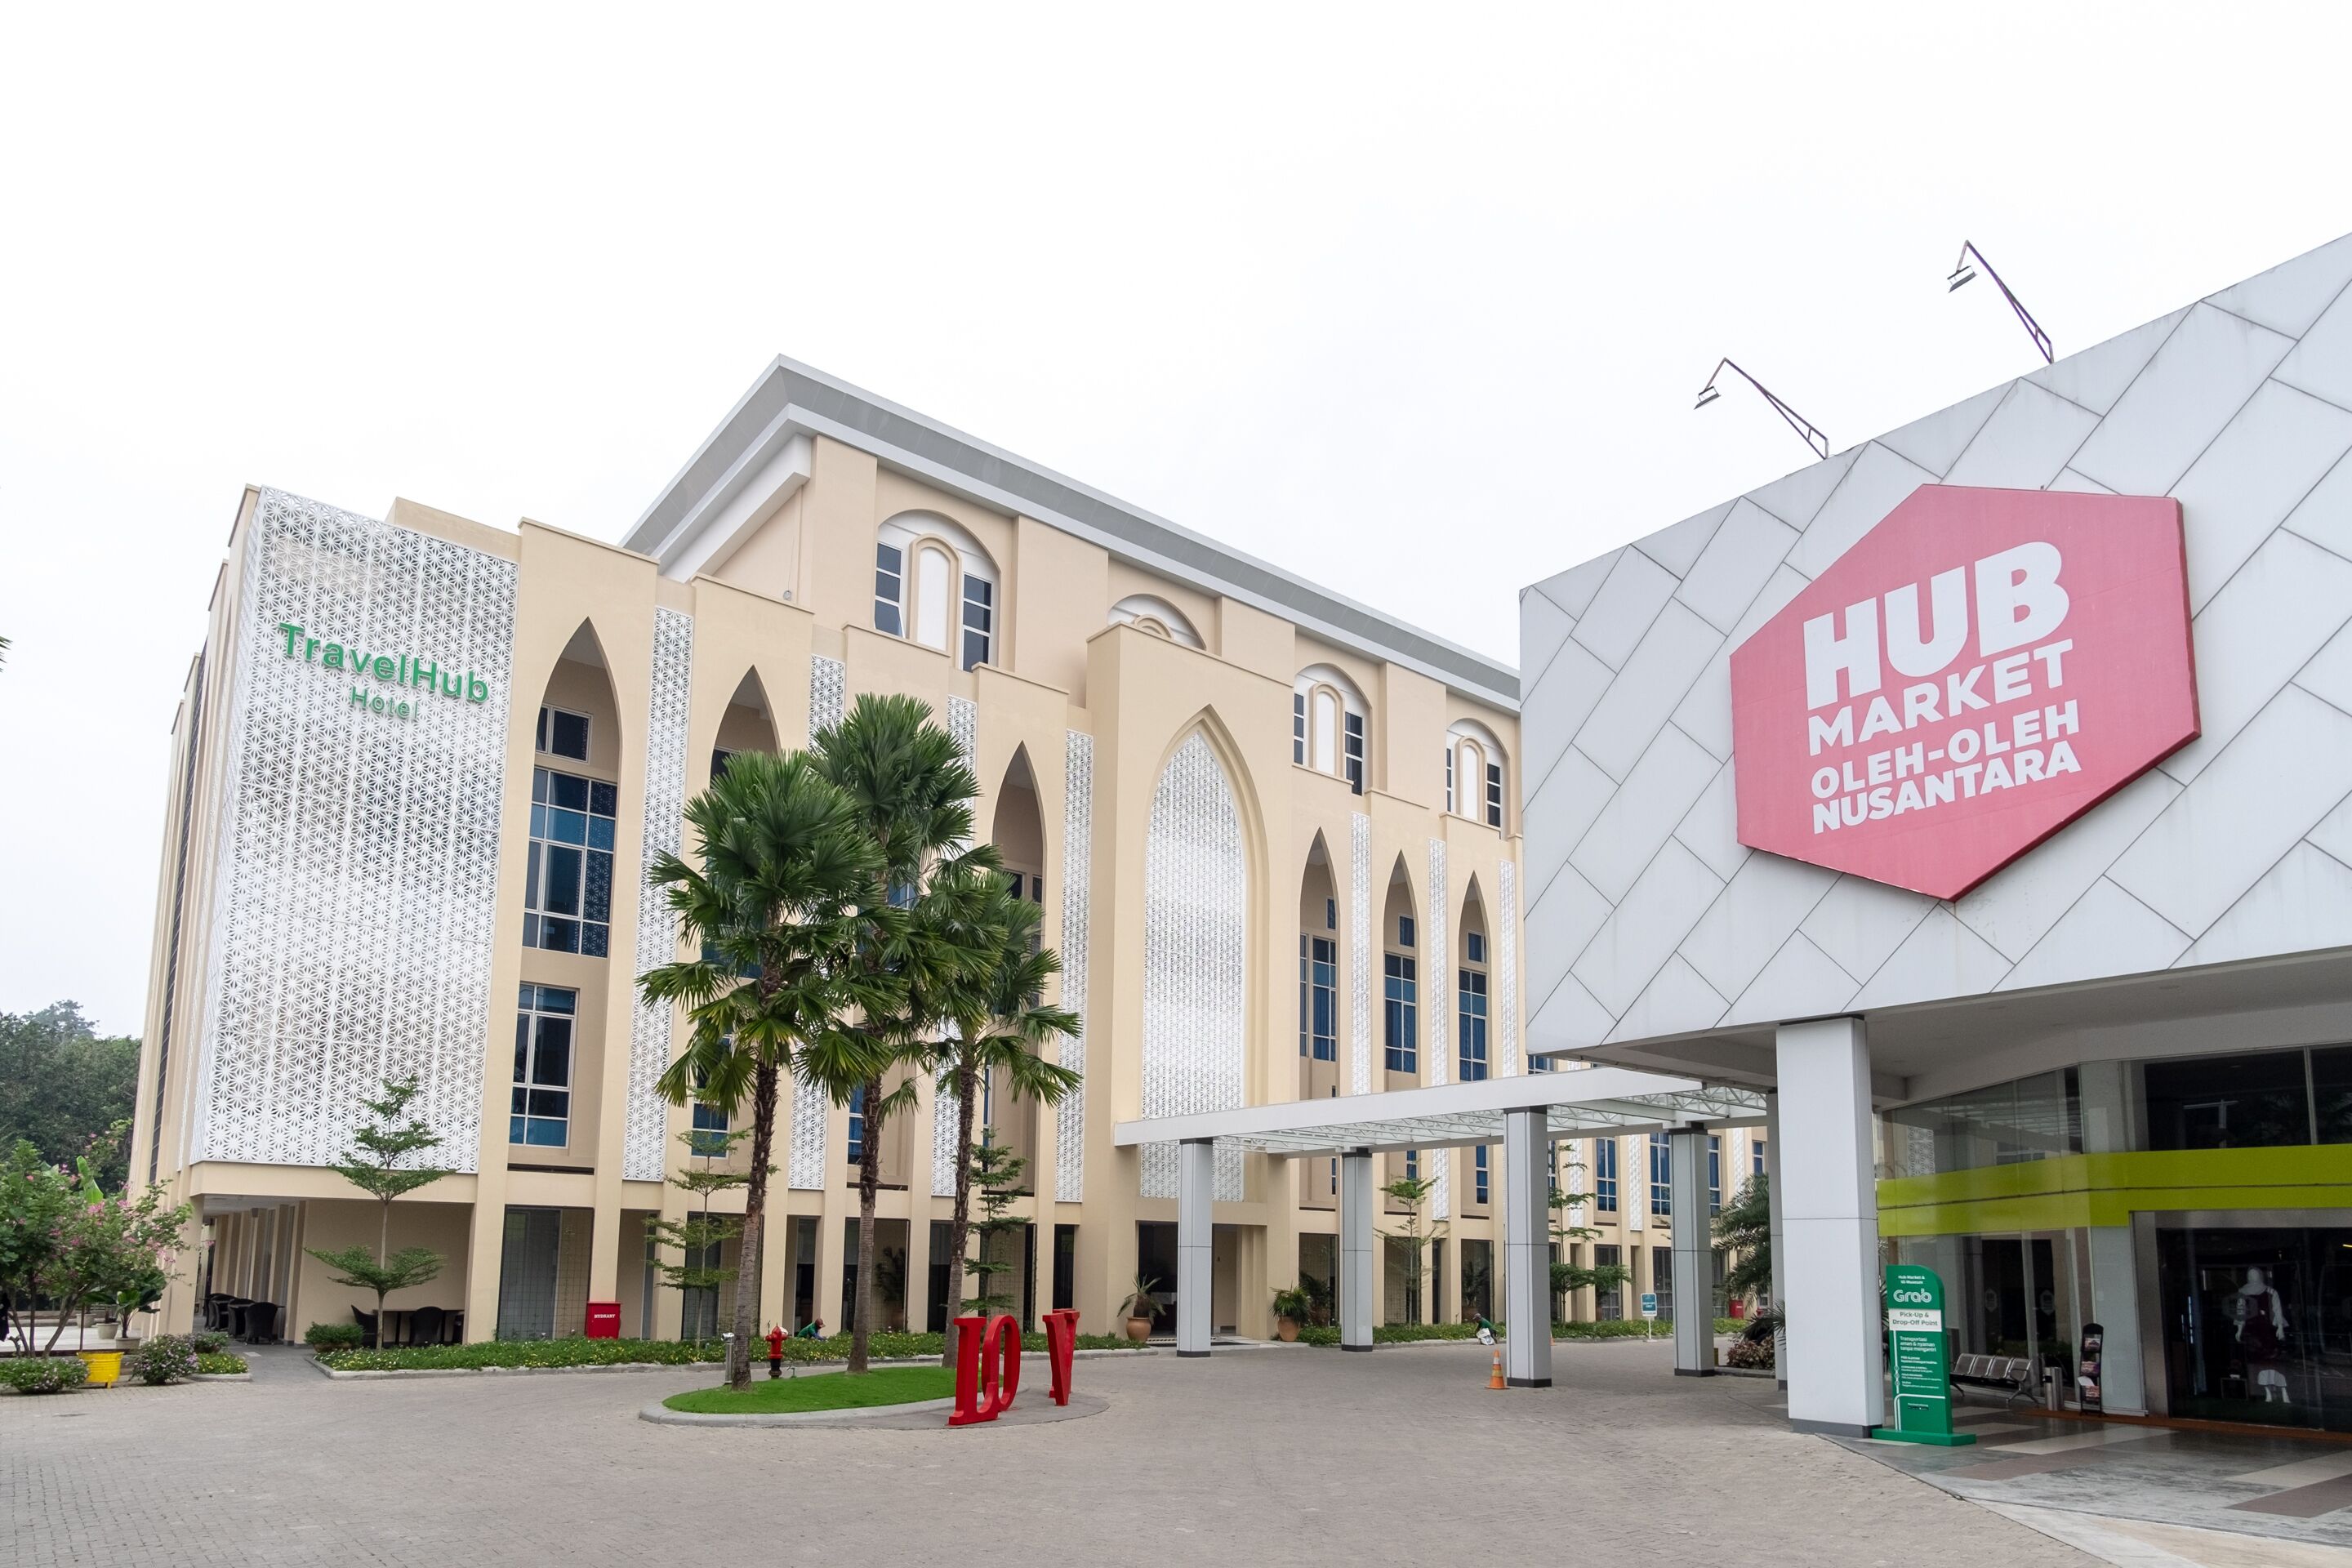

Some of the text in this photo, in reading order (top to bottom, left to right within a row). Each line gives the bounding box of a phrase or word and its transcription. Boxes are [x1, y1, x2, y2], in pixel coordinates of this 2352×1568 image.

[279, 622, 488, 703] TravelHub
[1803, 541, 2069, 710] HUB
[351, 687, 418, 719] Hotel
[1808, 639, 2073, 756] MARKET
[1811, 699, 2079, 799] OLEH-OLEH
[1813, 740, 2082, 834] NUSANTARA
[1893, 1288, 1932, 1303] Grab
